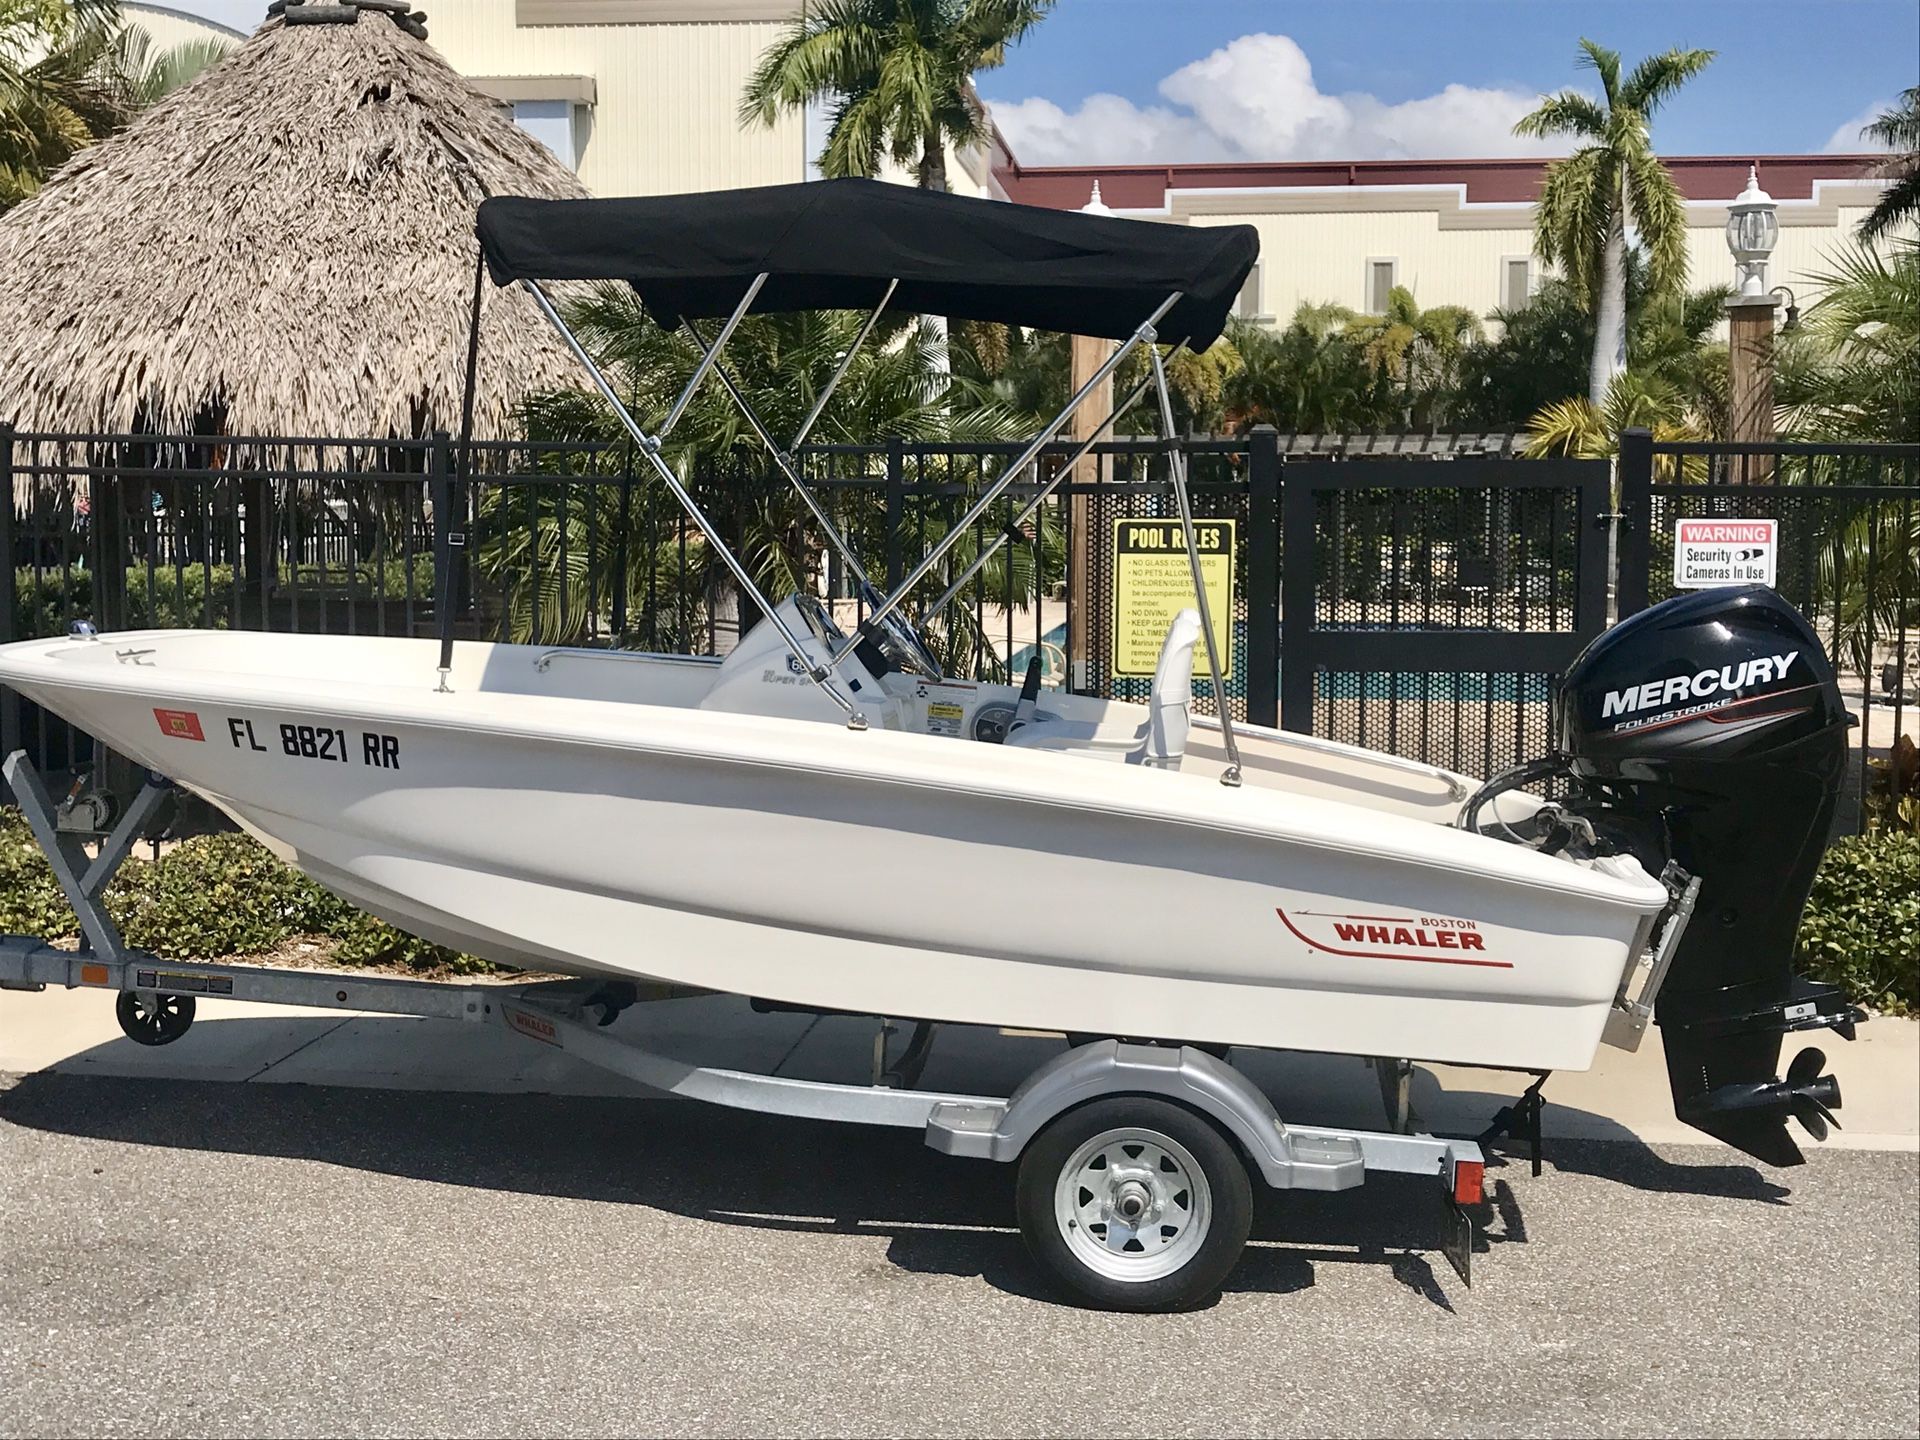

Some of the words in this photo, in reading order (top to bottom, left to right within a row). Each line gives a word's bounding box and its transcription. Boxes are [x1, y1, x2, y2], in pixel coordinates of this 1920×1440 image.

[1129, 528, 1167, 548] POOL
[1687, 527, 1766, 541] WARNING
[1132, 559, 1143, 567] NO
[1145, 559, 1169, 567] GLASS
[1687, 548, 1731, 564] Security
[1686, 565, 1730, 579] Cameras
[1733, 565, 1743, 579] In
[1746, 565, 1764, 579] Use
[1142, 590, 1186, 598] accompanied
[1187, 590, 1196, 599] by
[1131, 609, 1142, 617] NO
[1143, 609, 1168, 617] DIVING
[1131, 619, 1151, 627] KEEP
[1131, 629, 1144, 637] ALL
[1146, 629, 1168, 637] TIMES
[1131, 639, 1153, 647] Marina
[1601, 651, 1798, 718] MERCURY
[1614, 698, 1731, 732] FOURSTROKE
[227, 717, 267, 752] FL
[279, 723, 348, 763] 8821
[362, 732, 400, 769] RR
[1421, 917, 1476, 930] BOSTON
[1333, 923, 1486, 951] WHALER
